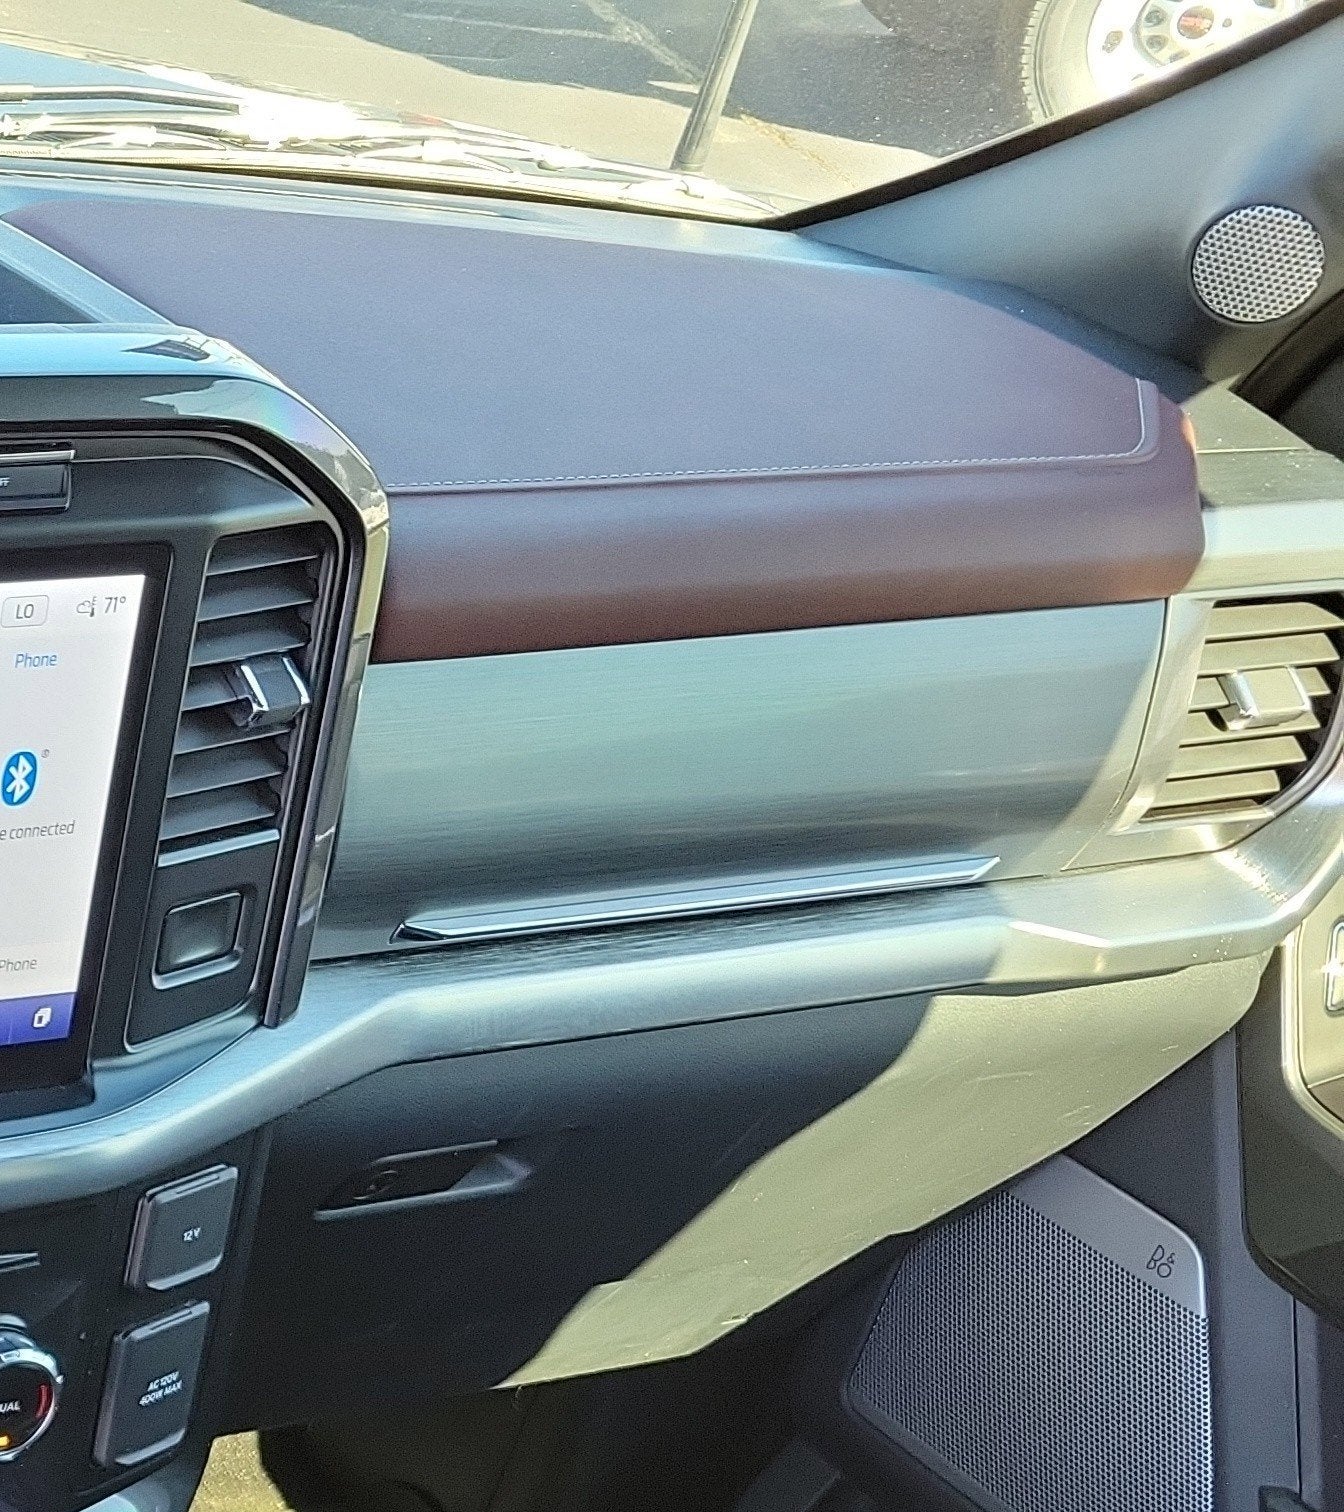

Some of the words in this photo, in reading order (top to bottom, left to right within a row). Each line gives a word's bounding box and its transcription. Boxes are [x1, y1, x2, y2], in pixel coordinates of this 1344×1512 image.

[16, 603, 34, 619] LO
[15, 652, 58, 668] Phone
[9, 819, 75, 840] connected
